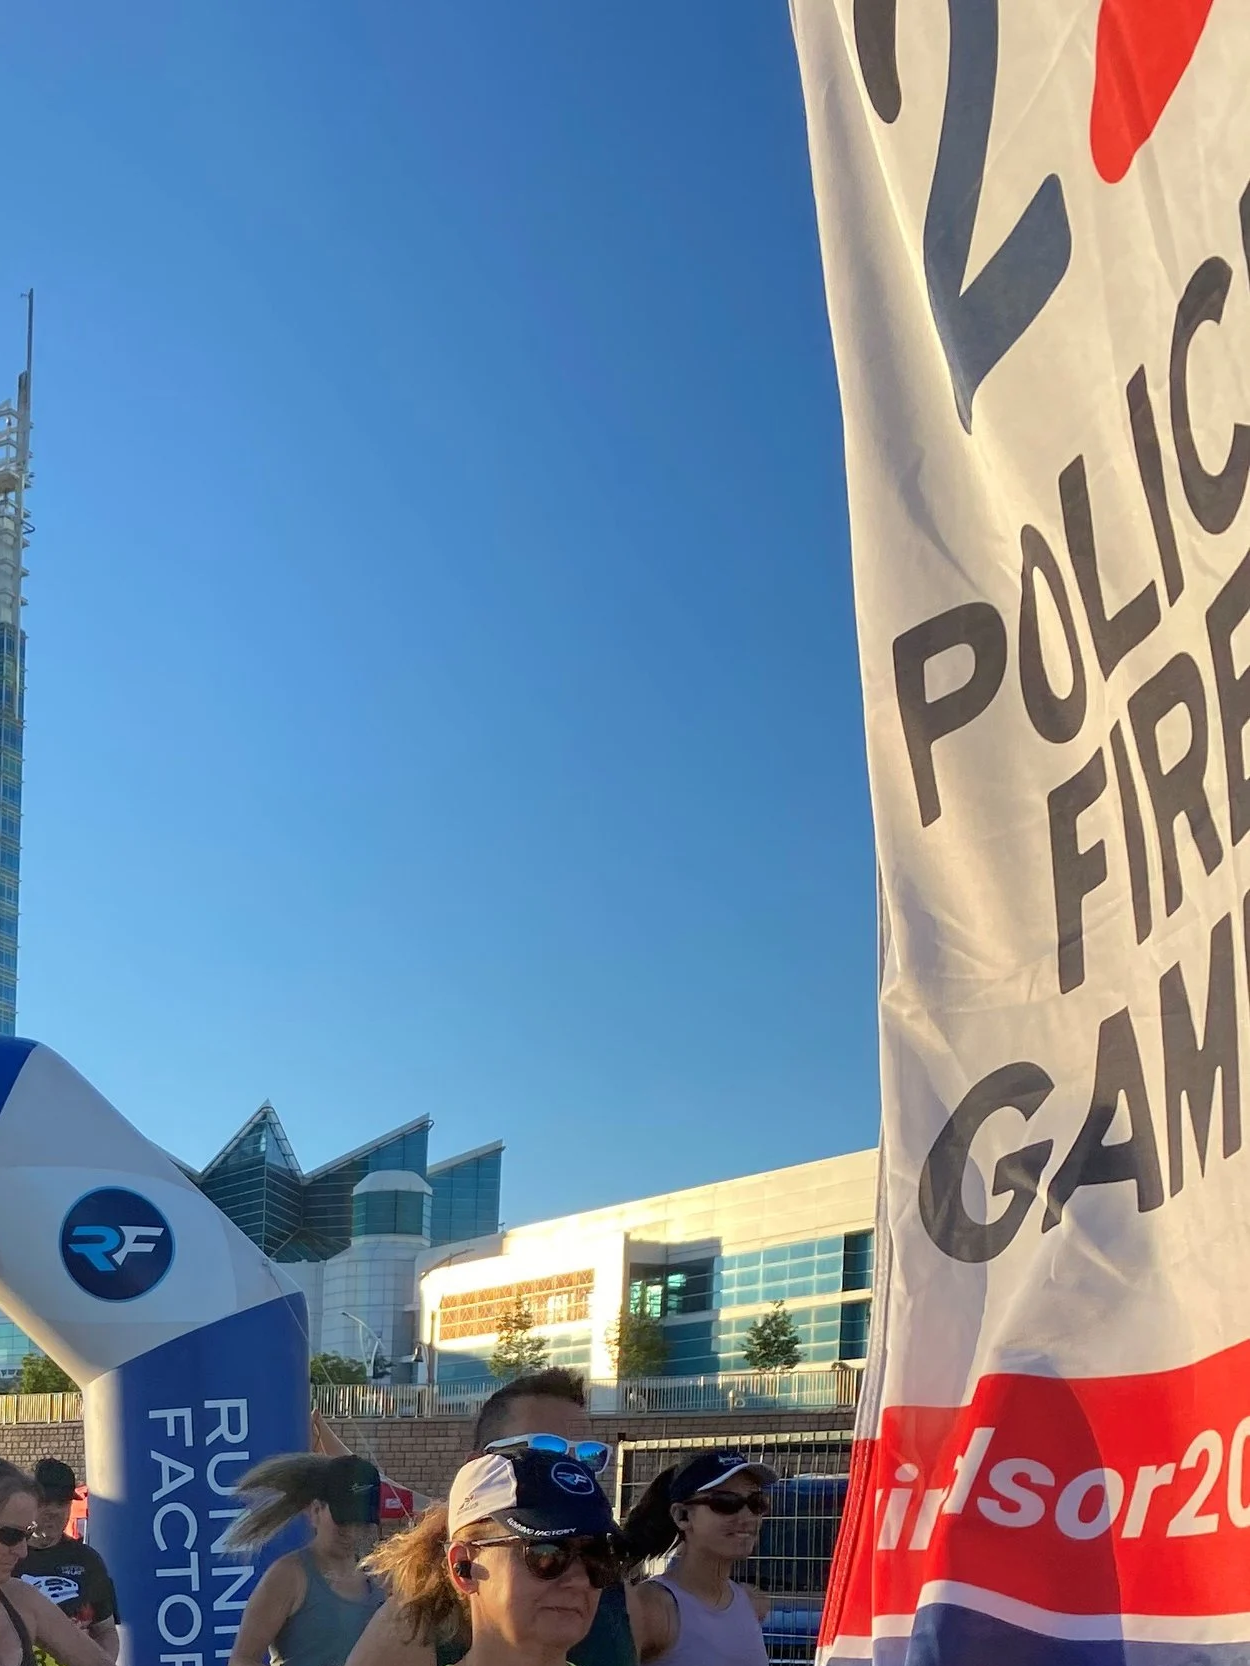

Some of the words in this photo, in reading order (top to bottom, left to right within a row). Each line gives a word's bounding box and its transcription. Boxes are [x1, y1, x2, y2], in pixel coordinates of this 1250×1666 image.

[893, 178, 1250, 828] POLIC
[68, 1225, 164, 1271] RF
[919, 888, 1250, 1263] GAM
